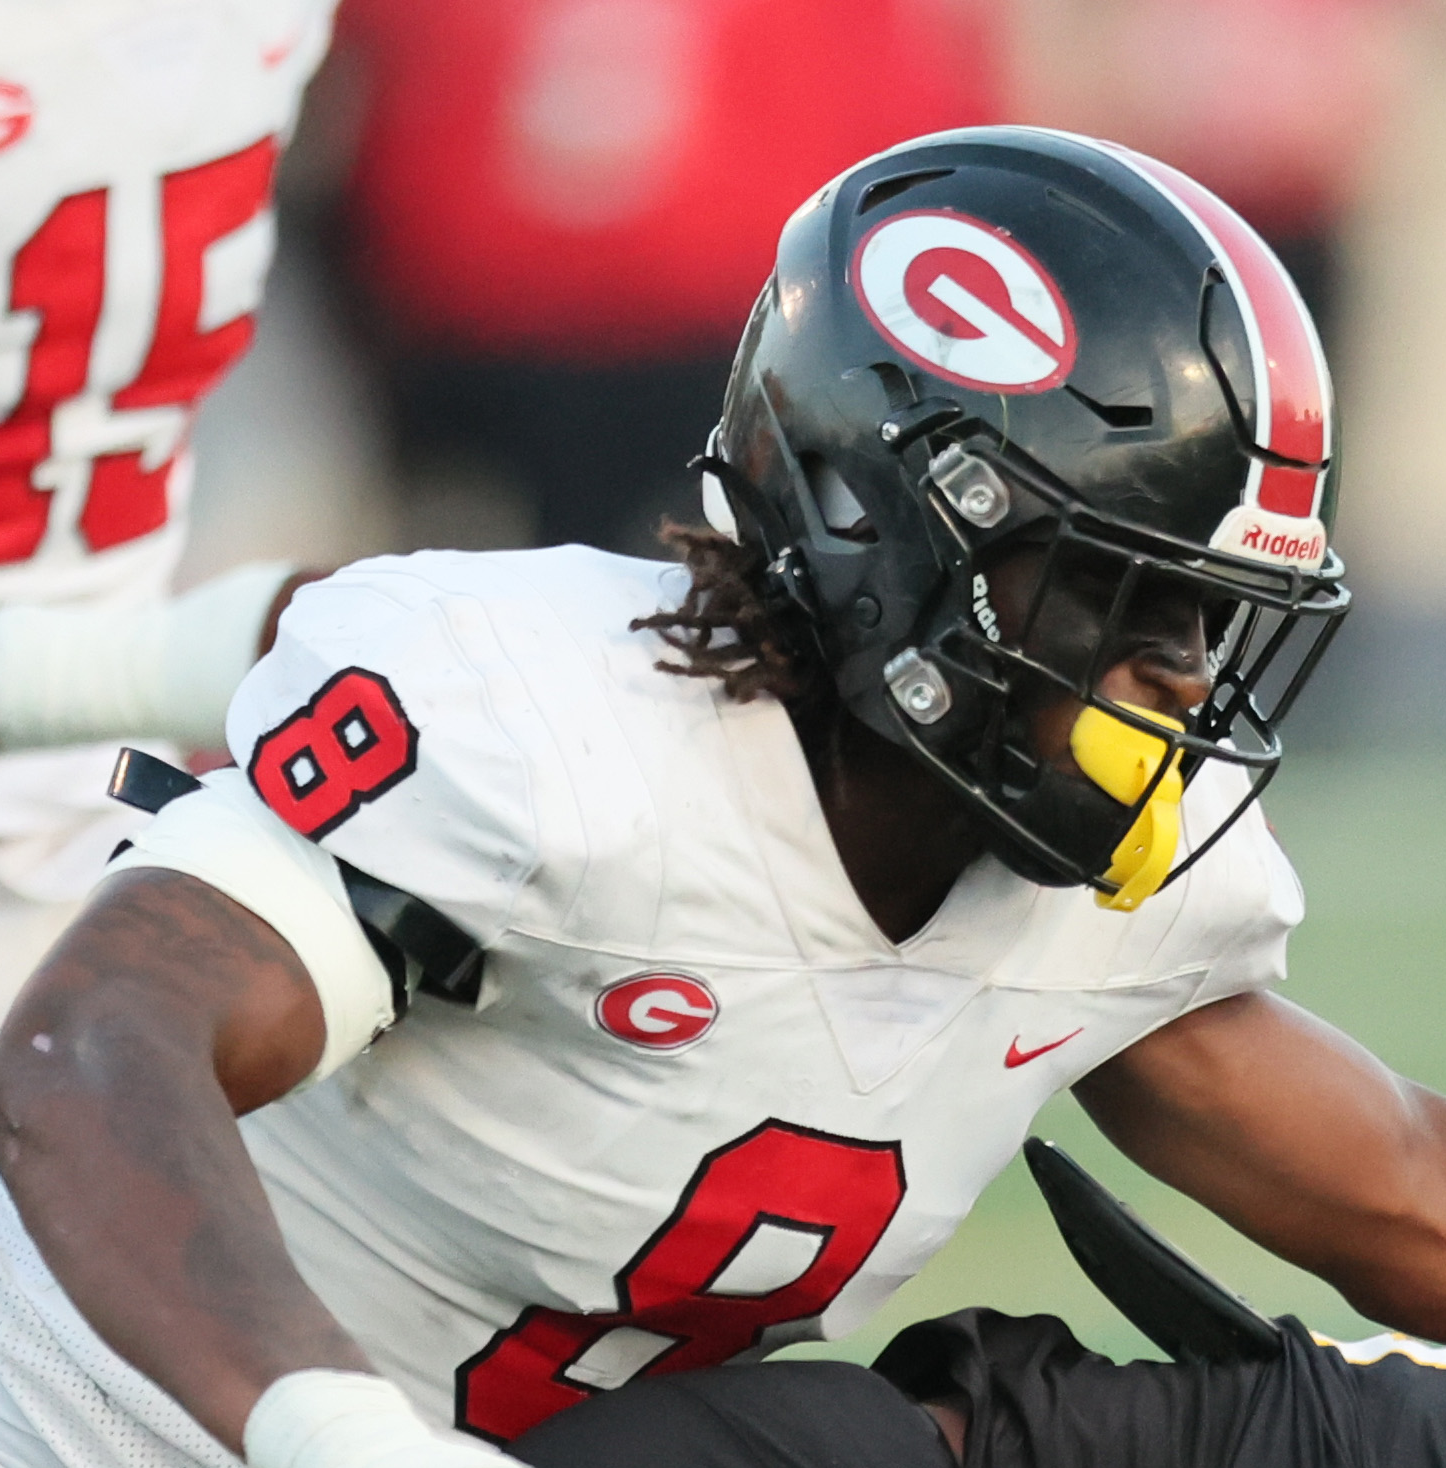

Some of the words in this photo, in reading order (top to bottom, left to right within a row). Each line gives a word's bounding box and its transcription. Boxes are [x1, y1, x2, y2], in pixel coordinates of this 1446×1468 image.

[859, 214, 1069, 387] G
[1241, 523, 1321, 560] Riddell
[246, 666, 420, 842] 8
[600, 976, 715, 1047] G
[454, 1117, 907, 1445] 8
